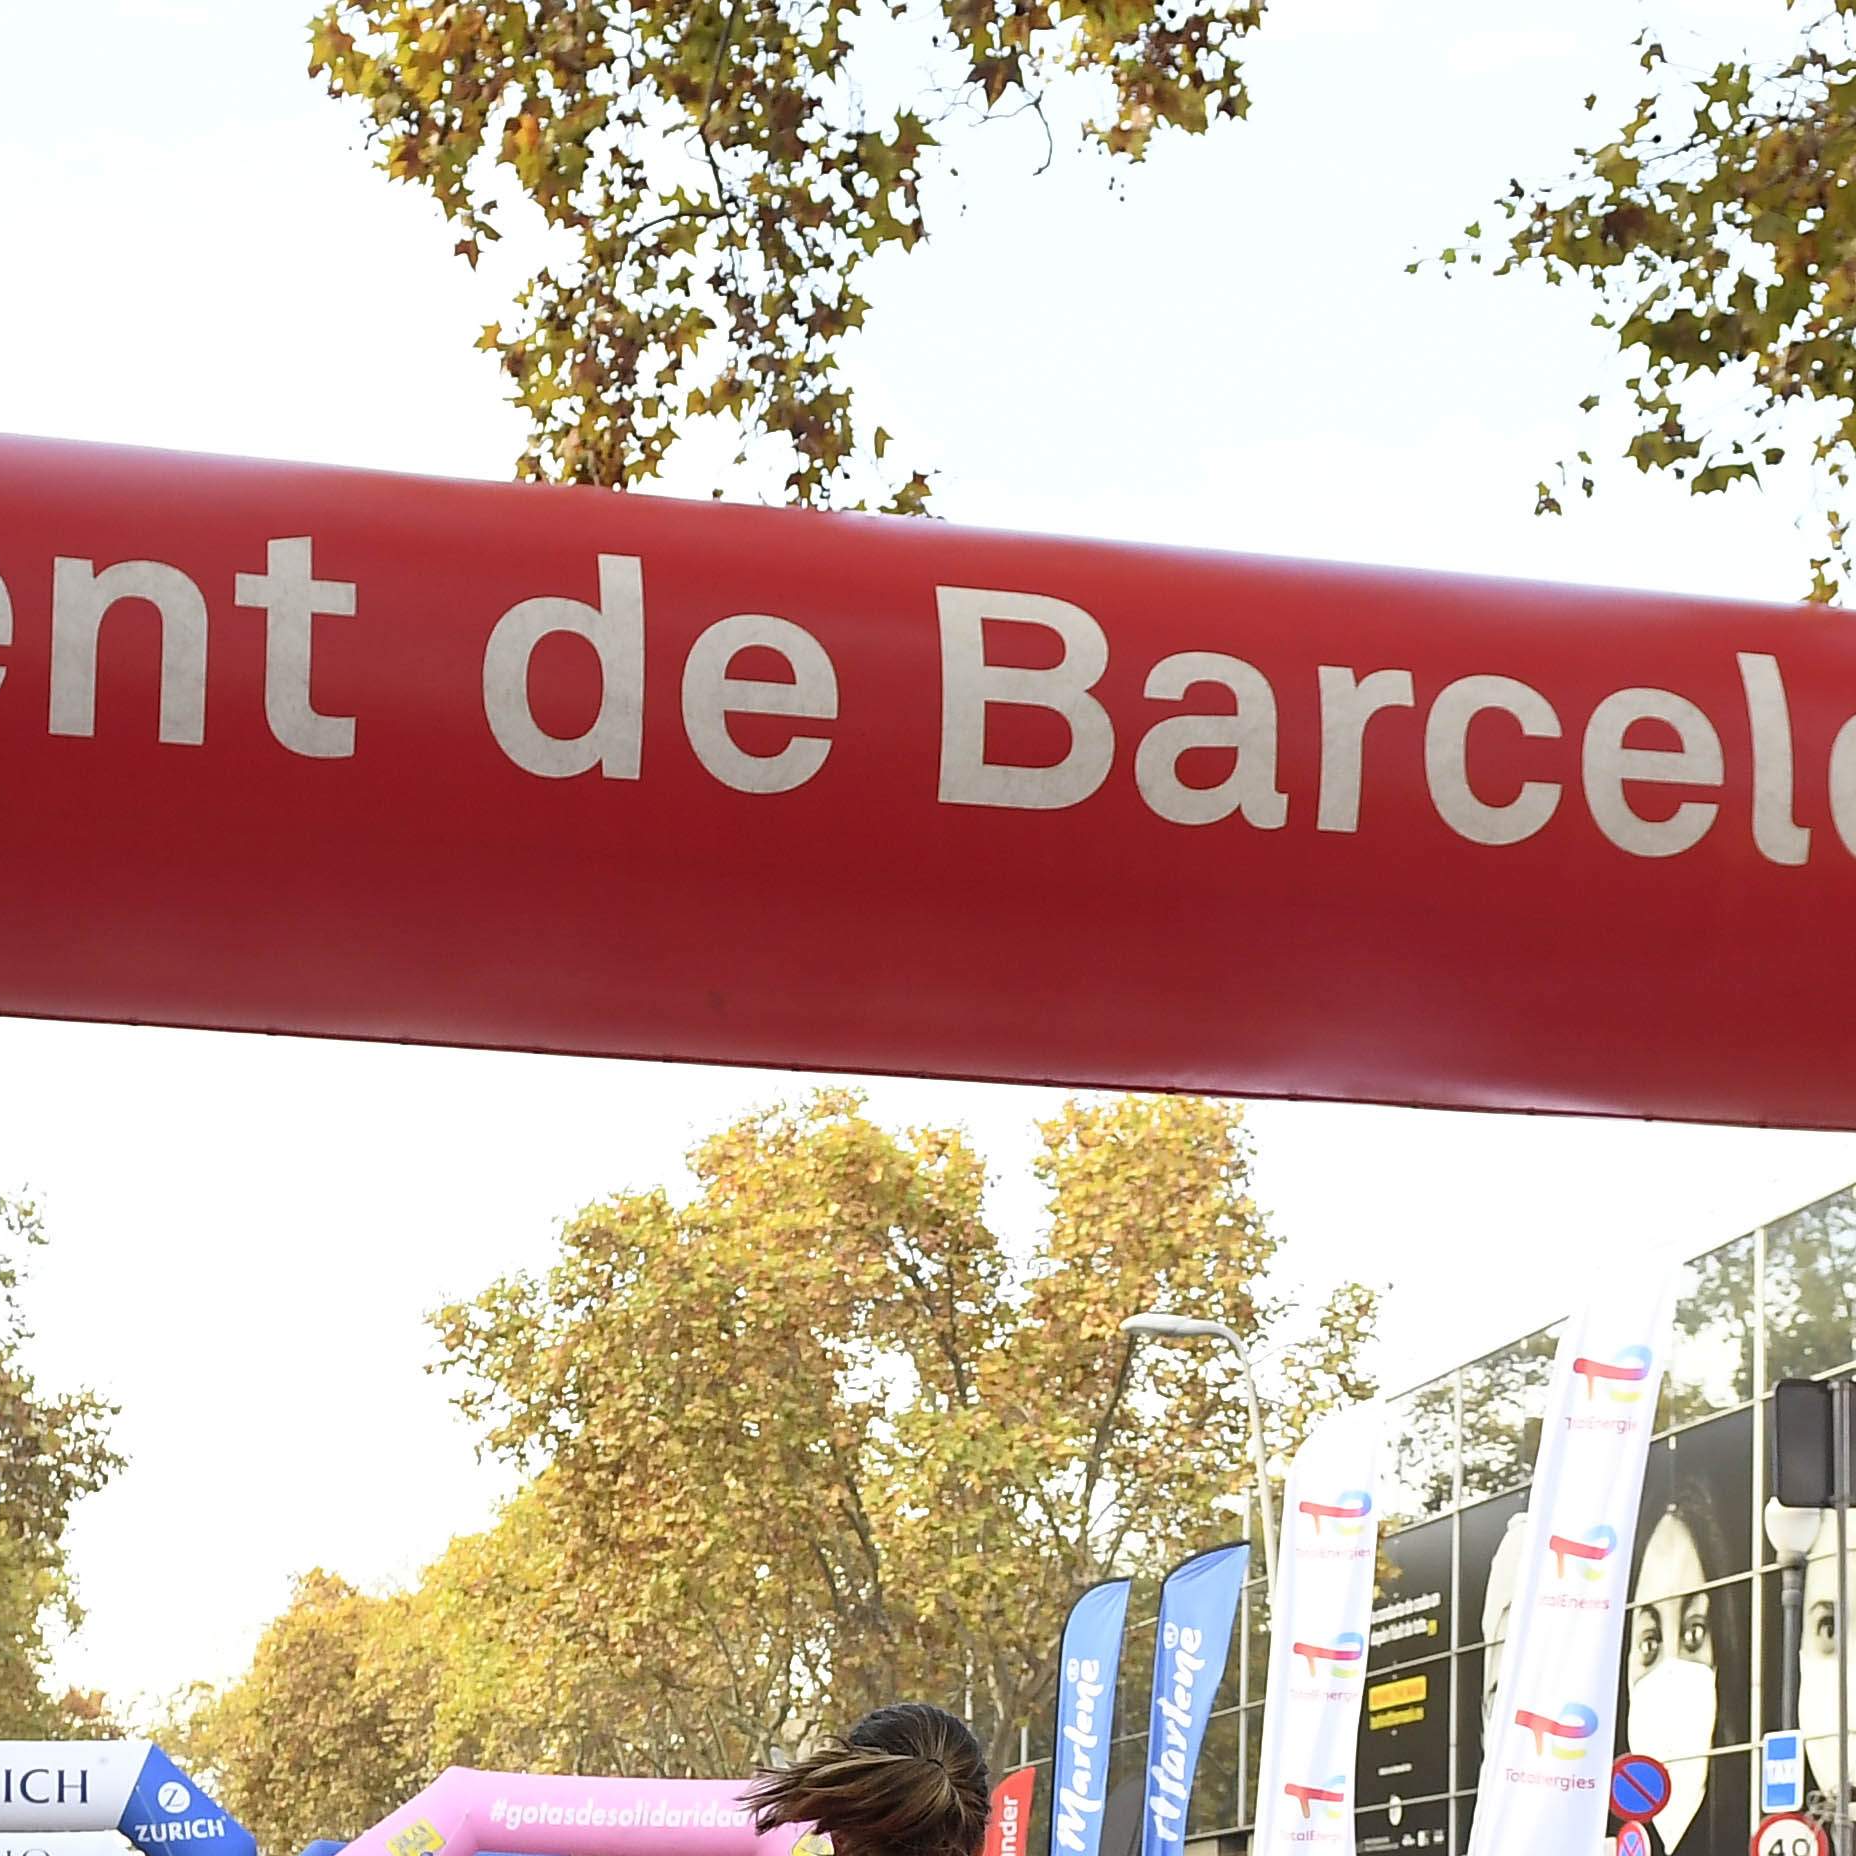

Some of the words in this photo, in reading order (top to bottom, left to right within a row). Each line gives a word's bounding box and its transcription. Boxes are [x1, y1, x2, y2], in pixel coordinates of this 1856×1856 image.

[482, 554, 839, 794] de
[135, 1818, 225, 1842] ZURICH
[1057, 1658, 1104, 1853] Marlene
